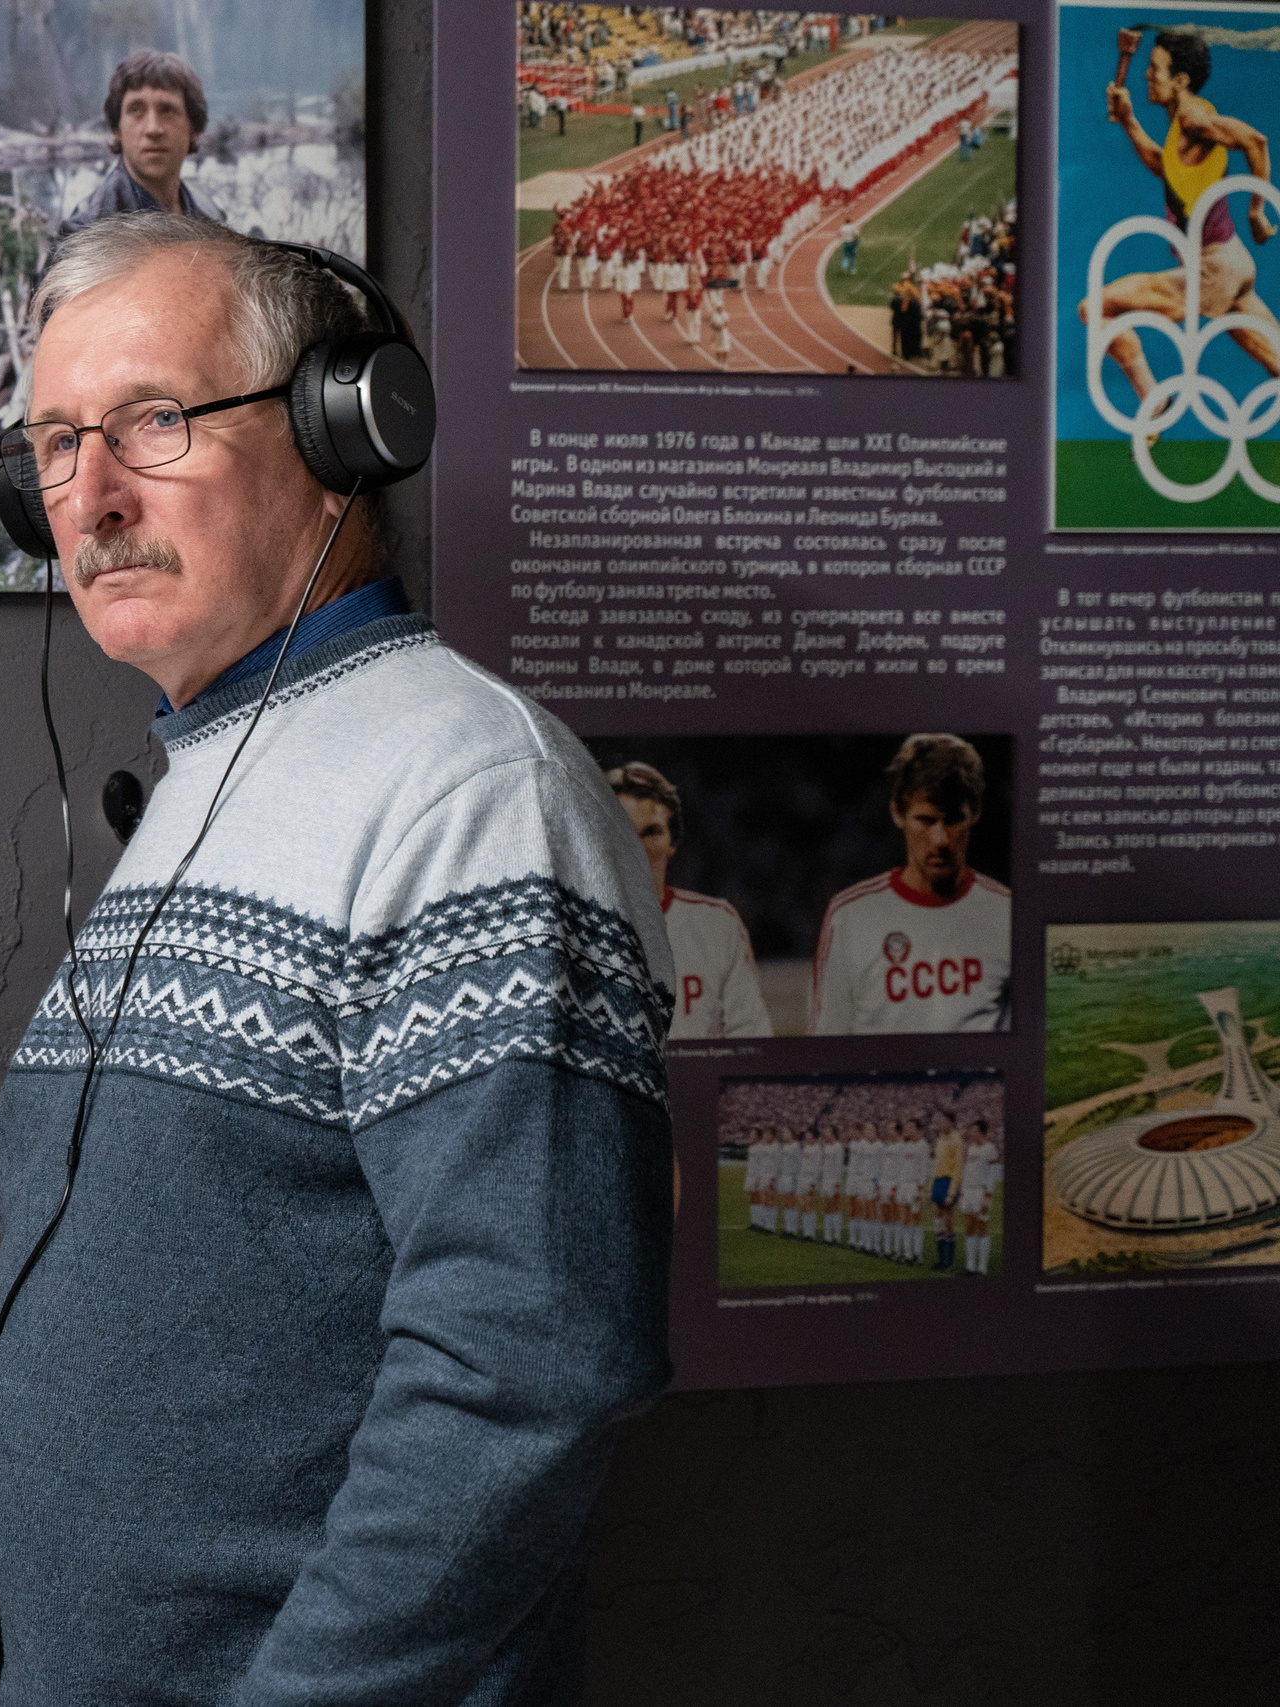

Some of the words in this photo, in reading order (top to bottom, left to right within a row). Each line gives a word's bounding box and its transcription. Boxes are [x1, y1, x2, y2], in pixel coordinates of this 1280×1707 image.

[391, 391, 417, 415] SONY
[530, 428, 541, 447] В
[547, 433, 598, 449] конце
[604, 434, 648, 448] июля
[655, 431, 695, 449] 1976
[700, 435, 739, 452] года
[745, 436, 755, 449] в
[760, 432, 821, 453] Канаде
[826, 437, 860, 450] шли
[897, 433, 1007, 453] Олимпийские
[511, 458, 558, 476] игры.
[566, 454, 578, 473] В
[579, 459, 633, 476] одном
[635, 459, 655, 474] из
[657, 460, 744, 475] магазинов
[746, 457, 828, 479] Монреаля
[830, 457, 911, 480] Владимир
[913, 457, 994, 480] Высоцкий
[996, 464, 1007, 477] и
[511, 479, 575, 501] Марина
[582, 479, 634, 501] Влади
[639, 481, 717, 503] случайно
[722, 485, 807, 503] встретили
[812, 486, 898, 501] известных
[902, 482, 1007, 506] футболистов
[511, 504, 598, 523] Советской
[599, 504, 670, 527] сборной
[672, 506, 720, 524] Олега
[722, 506, 793, 525] Блохина
[794, 511, 806, 525] и
[808, 506, 878, 527] Леонида
[880, 507, 943, 530] Буряка.
[530, 530, 702, 553] Незапланированная
[715, 534, 781, 553] встреча
[793, 535, 887, 551] состоялась
[898, 536, 947, 555] сразу
[957, 536, 1007, 551] после
[510, 559, 602, 574] окончания
[607, 556, 727, 574] олимпийского
[730, 560, 803, 579] турнира,
[806, 561, 818, 575] в
[822, 561, 891, 579] котором
[895, 556, 963, 579] сборная
[967, 556, 1007, 575] СССР
[511, 585, 532, 599] по
[534, 580, 605, 603] футболу
[607, 585, 665, 599] заняла
[666, 585, 720, 603] третье
[722, 585, 776, 600] место.
[530, 606, 589, 627] Беседа
[599, 610, 692, 624] завязалась
[700, 610, 753, 628] сходу,
[761, 610, 782, 624] из
[791, 610, 904, 628] супермаркета
[913, 610, 941, 624] все
[950, 610, 1006, 624] вместе
[1039, 616, 1135, 635] услышать
[1149, 615, 1276, 634] выступление
[511, 635, 580, 650] поехали
[593, 635, 603, 649] к
[616, 632, 704, 651] канадской
[716, 635, 782, 652] актрисе
[792, 630, 846, 653] Диане
[940, 635, 1006, 653] подруге
[511, 656, 578, 678] Марины
[588, 656, 644, 677] Влади,
[653, 660, 664, 673] в
[672, 660, 715, 676] доме
[724, 655, 792, 677] которой
[800, 659, 866, 678] супруги
[874, 660, 918, 673] жили
[926, 659, 948, 673] во
[955, 659, 1005, 677] время
[617, 685, 626, 699] в
[629, 681, 717, 703] Монреале.
[886, 958, 983, 1002] СССР
